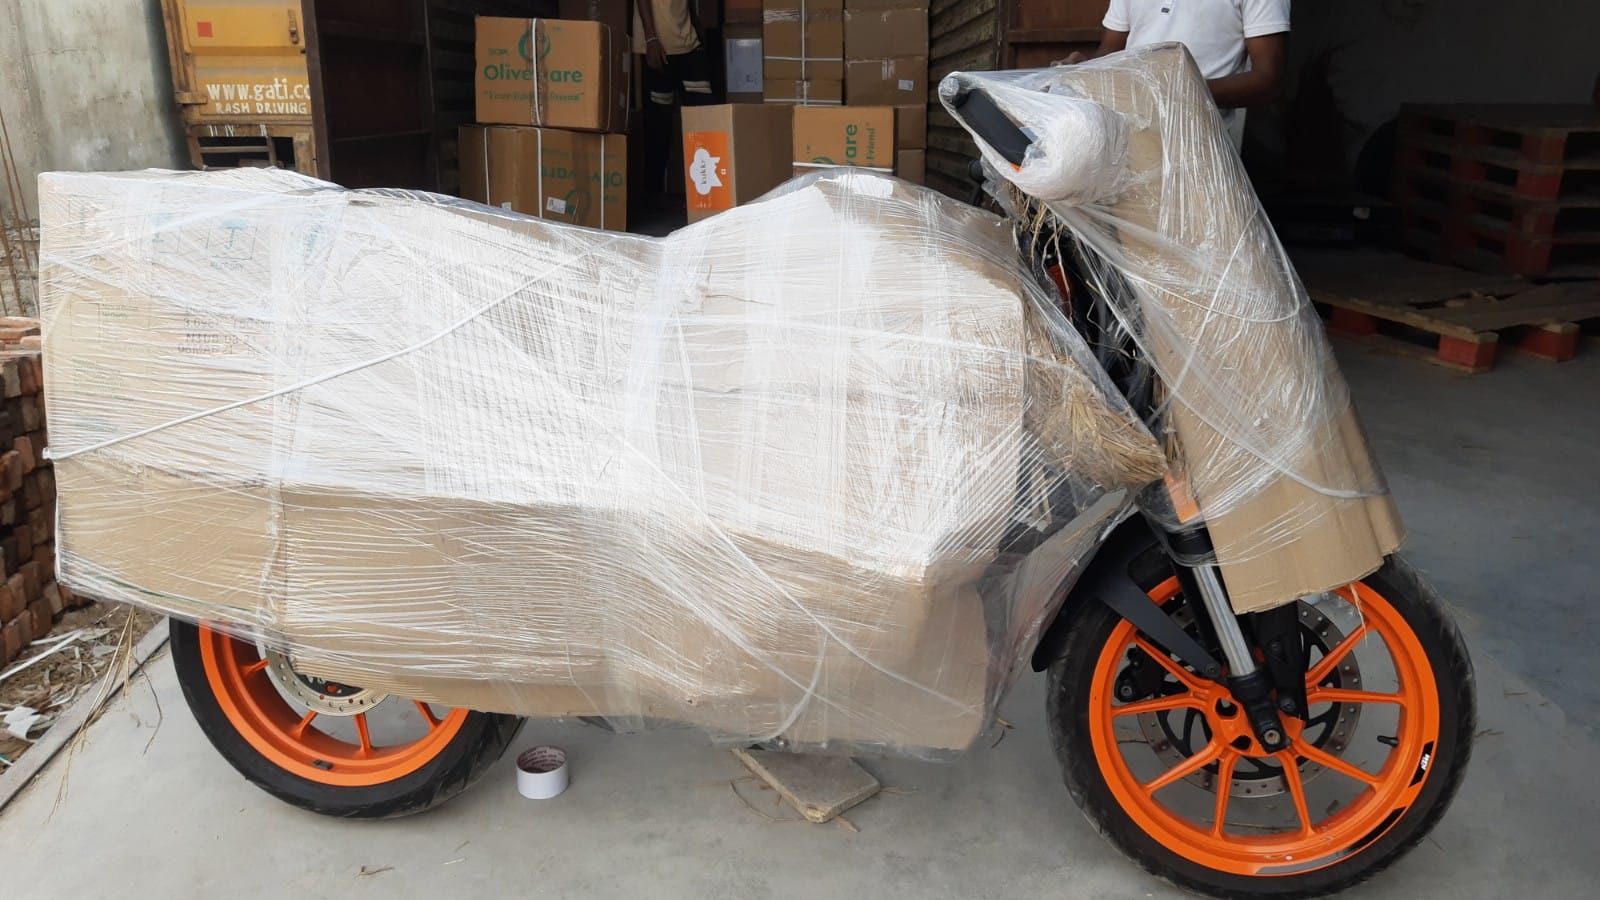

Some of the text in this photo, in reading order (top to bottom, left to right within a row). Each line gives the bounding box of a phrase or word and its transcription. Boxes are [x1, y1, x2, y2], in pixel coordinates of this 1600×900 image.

[484, 64, 583, 83] Oliveare
[215, 102, 307, 114] RASH DRIVING
